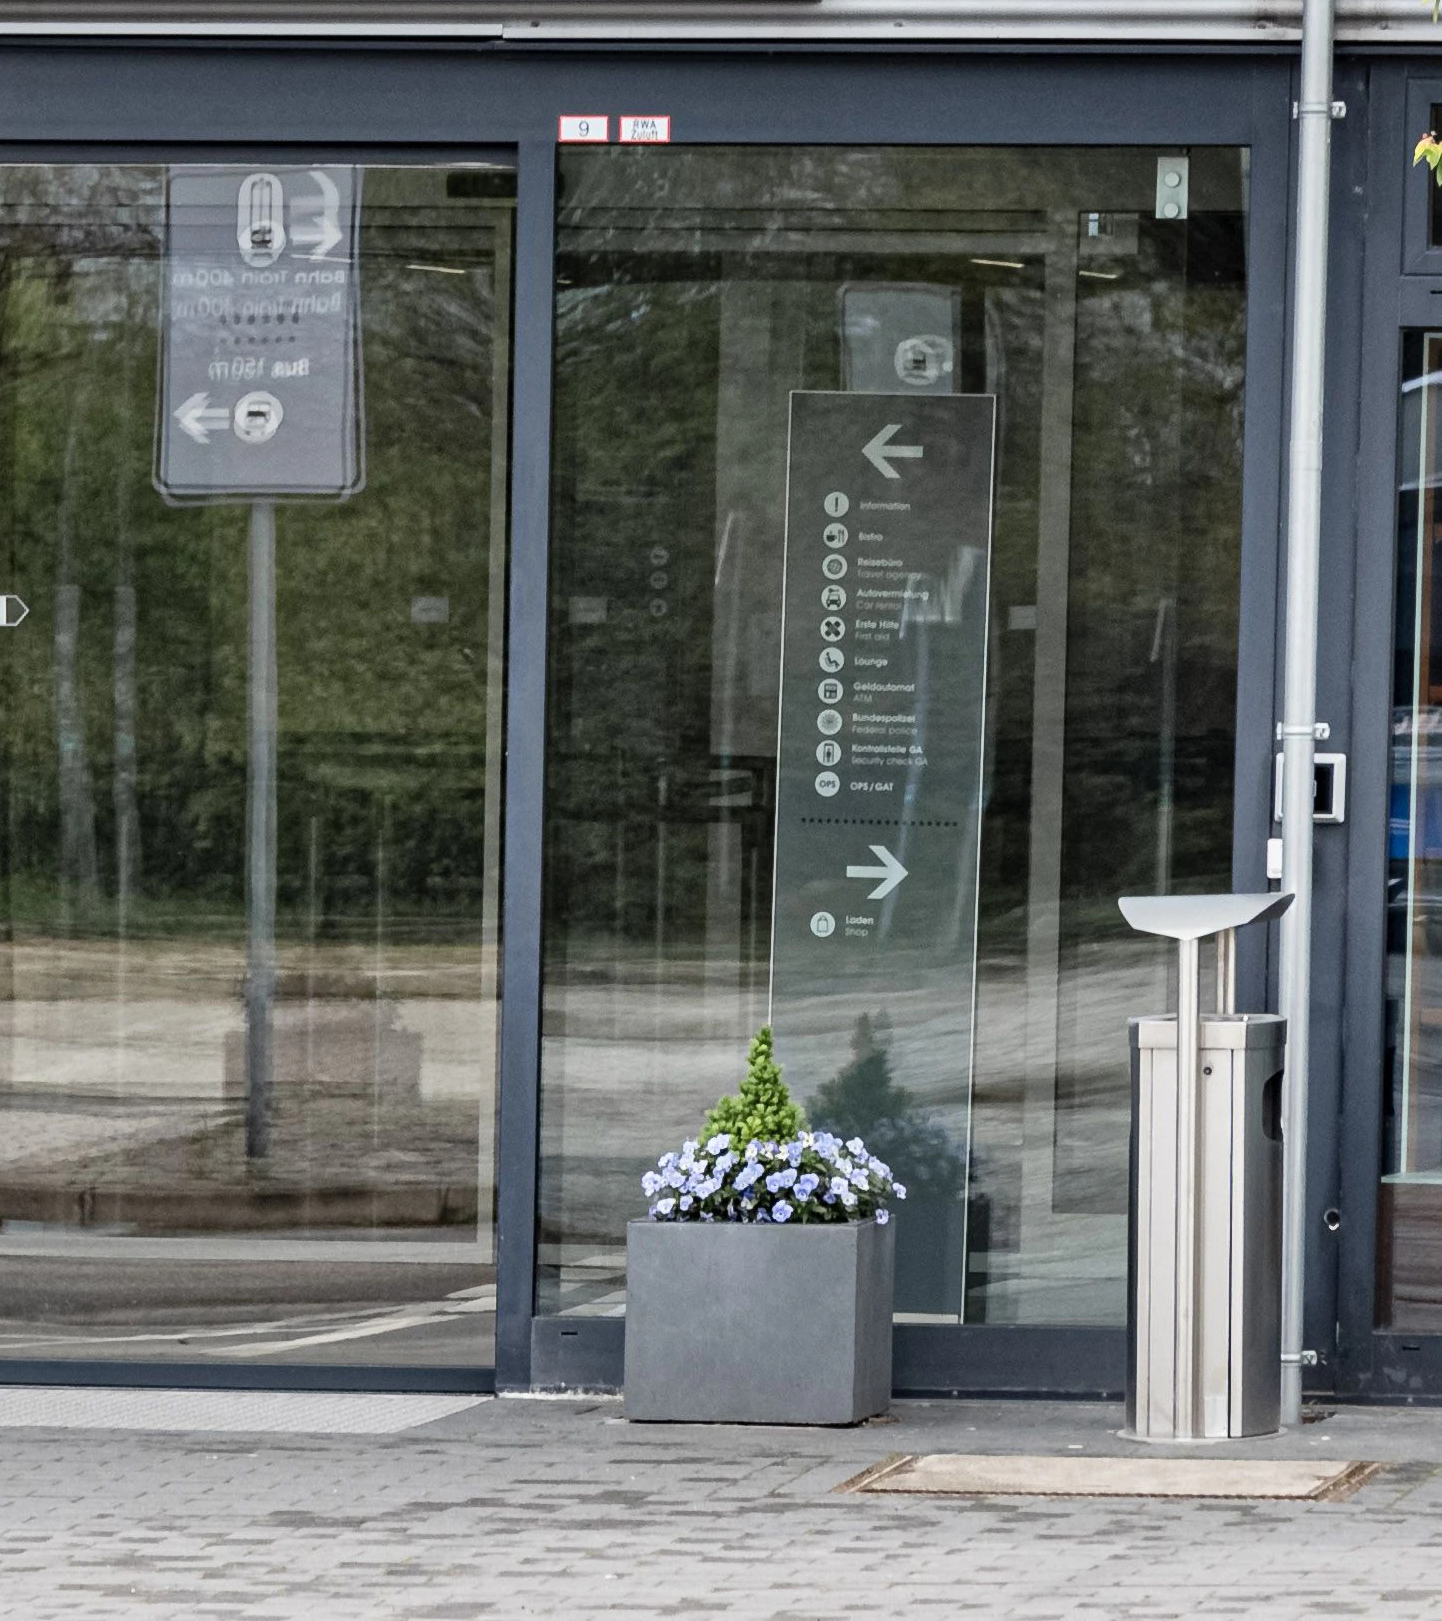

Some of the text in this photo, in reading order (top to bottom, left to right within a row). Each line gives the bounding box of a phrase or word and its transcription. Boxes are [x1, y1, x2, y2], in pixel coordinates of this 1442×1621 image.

[578, 120, 590, 138] 9
[634, 120, 657, 129] RWA
[860, 501, 911, 511] Information
[858, 532, 883, 542] Bistro
[857, 557, 903, 567] Reisebüro
[856, 589, 930, 600] Autovermietung
[854, 657, 888, 668] Lounge
[853, 682, 915, 692] Geldautomat
[853, 694, 873, 703] ATM
[852, 713, 916, 724] Bundespolizei
[819, 780, 836, 789] OPS
[846, 915, 874, 925] Laden
[845, 927, 869, 938] Shop
